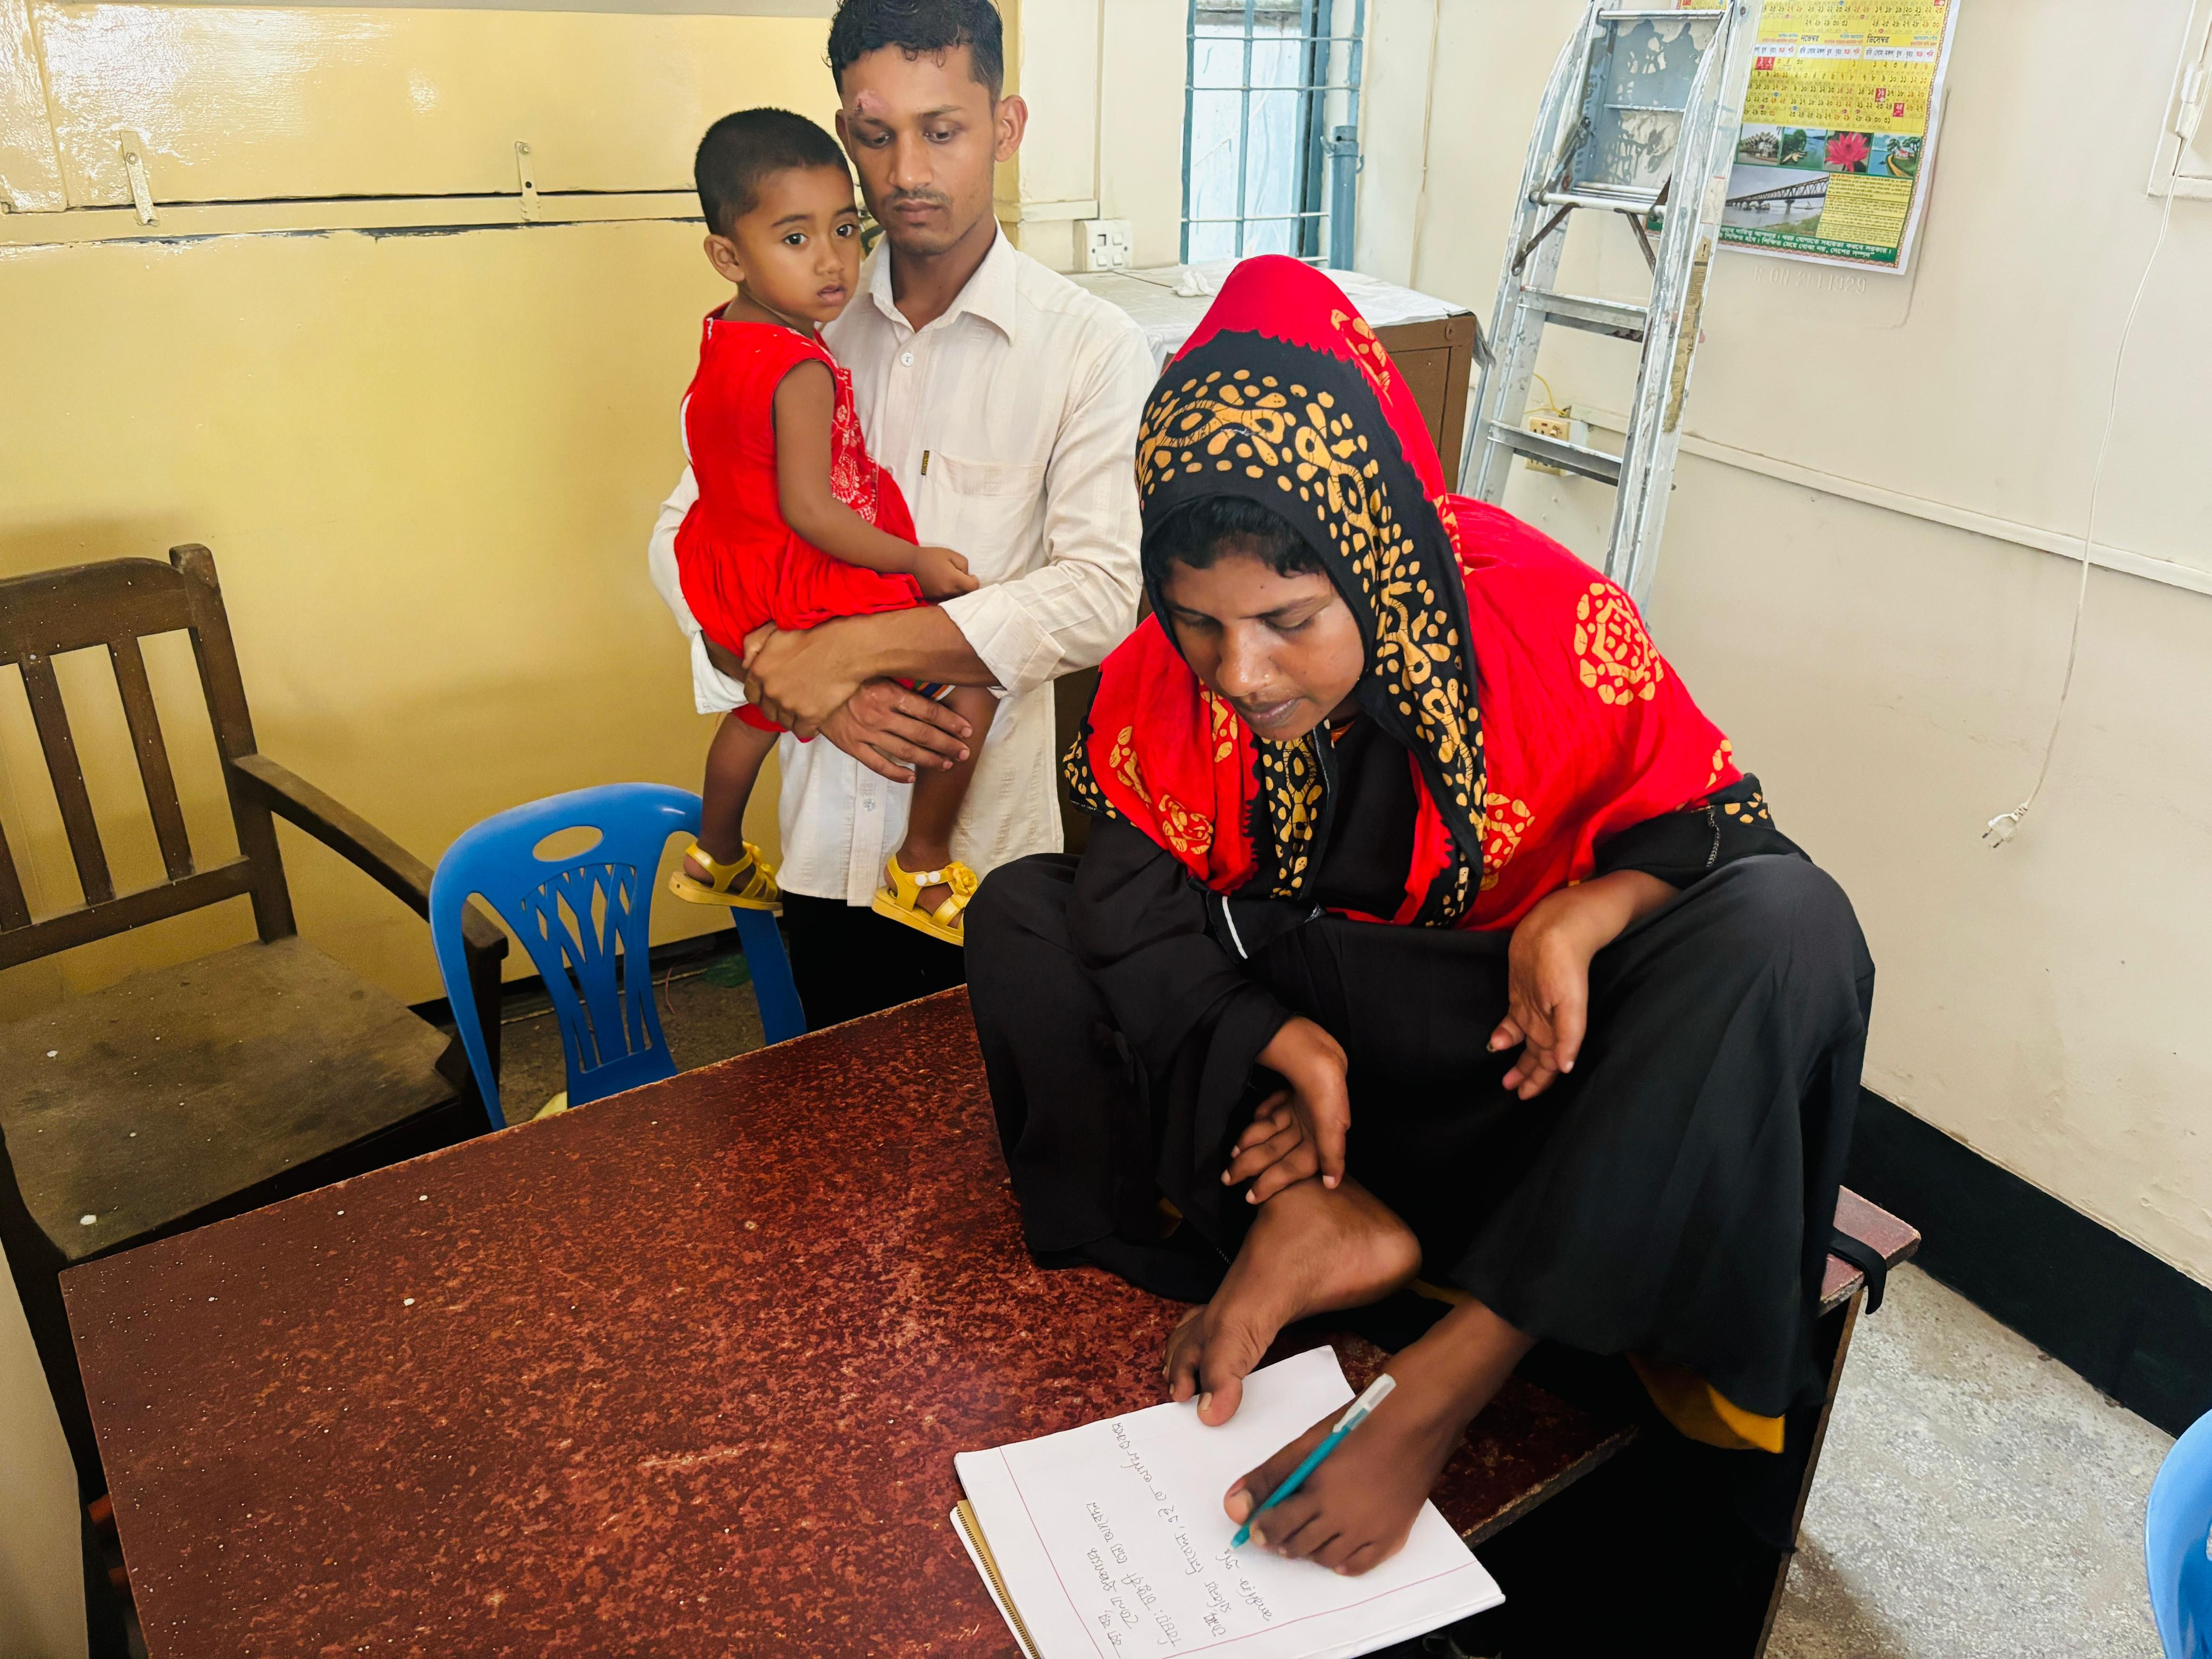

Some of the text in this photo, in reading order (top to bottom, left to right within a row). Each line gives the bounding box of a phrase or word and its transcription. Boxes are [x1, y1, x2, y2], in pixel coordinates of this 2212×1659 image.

[1867, 35, 1890, 44] ডিসেম্বর
[1158, 1505, 1178, 1522] এই
[1110, 1597, 1138, 1629] জেলা
